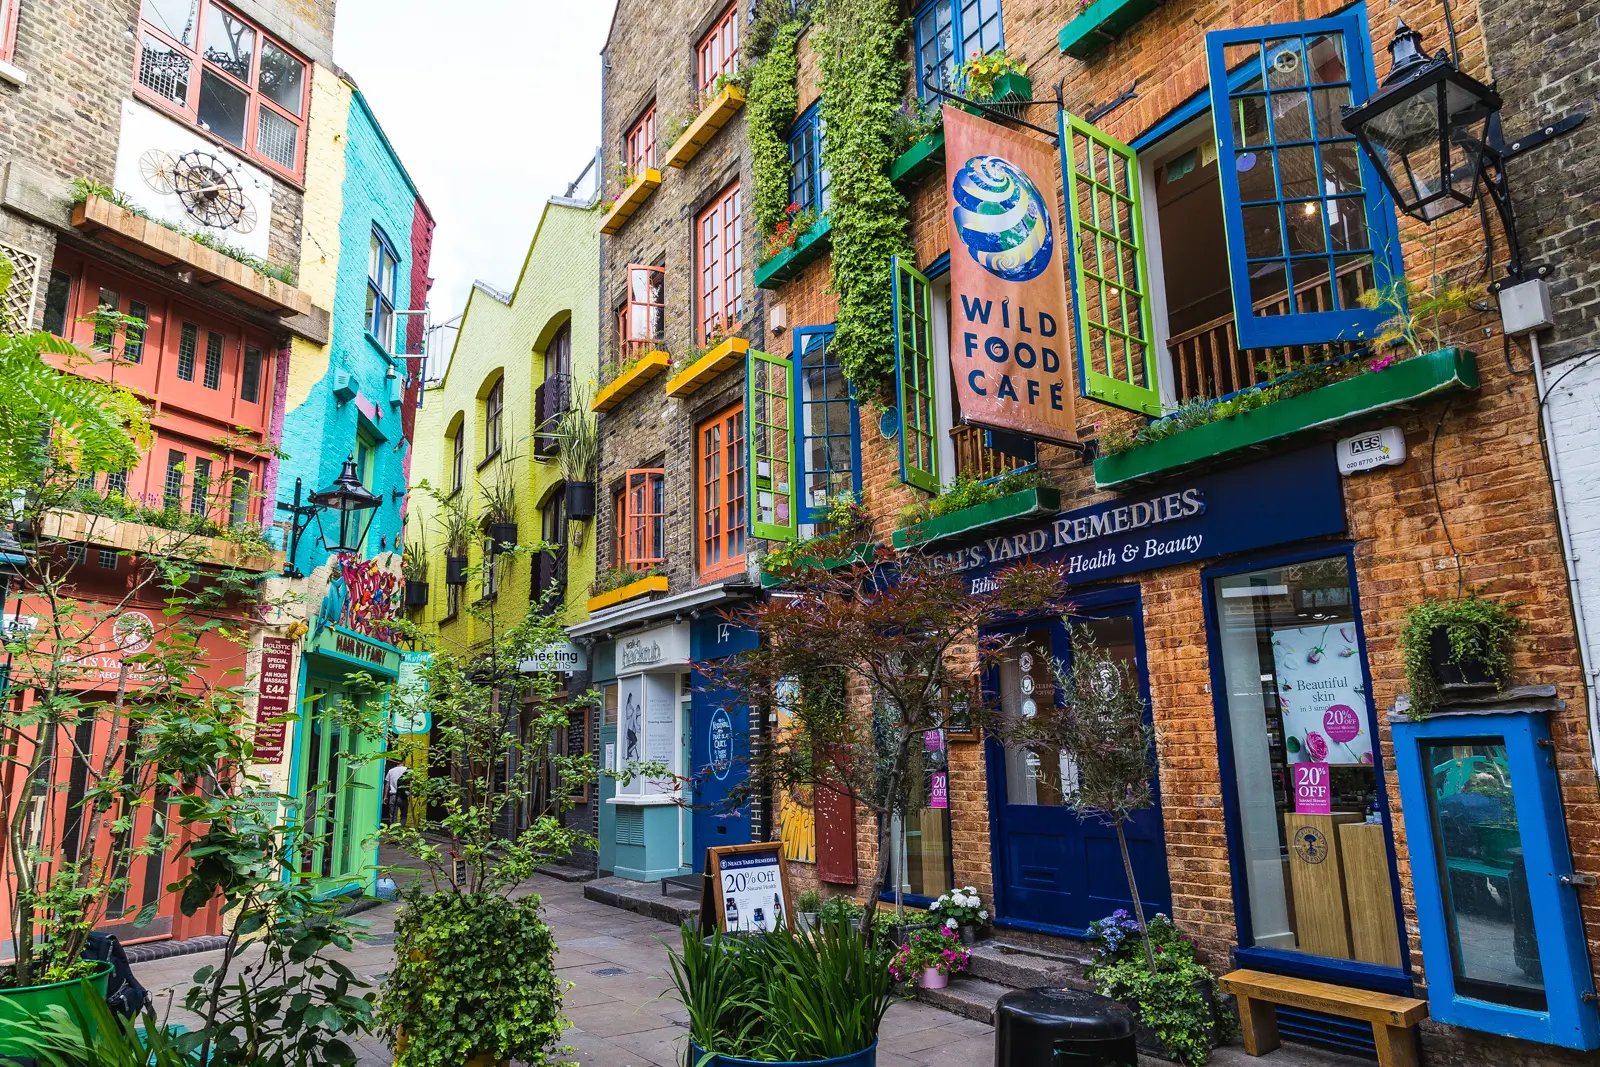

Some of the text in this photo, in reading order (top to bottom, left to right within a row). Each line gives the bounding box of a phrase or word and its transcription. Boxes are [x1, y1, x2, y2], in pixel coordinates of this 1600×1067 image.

[960, 294, 1057, 338] WILD
[963, 332, 1060, 374] FOOD
[1353, 437, 1380, 453] AES
[1375, 454, 1390, 462] 1244
[984, 529, 1046, 563] YARD
[1052, 489, 1200, 548] REMEDIES
[1068, 548, 1117, 575] Health
[1121, 544, 1140, 563] &
[1143, 534, 1203, 560] Beauty
[336, 634, 388, 666] HAIR BY FAIRY
[265, 685, 285, 694] £44
[1297, 676, 1349, 691] Beautiful
[1312, 691, 1336, 702] skin
[1325, 710, 1351, 725] 20%
[1298, 767, 1326, 785] 20%
[1298, 786, 1327, 797] OFF
[725, 870, 776, 893] 20% Off
